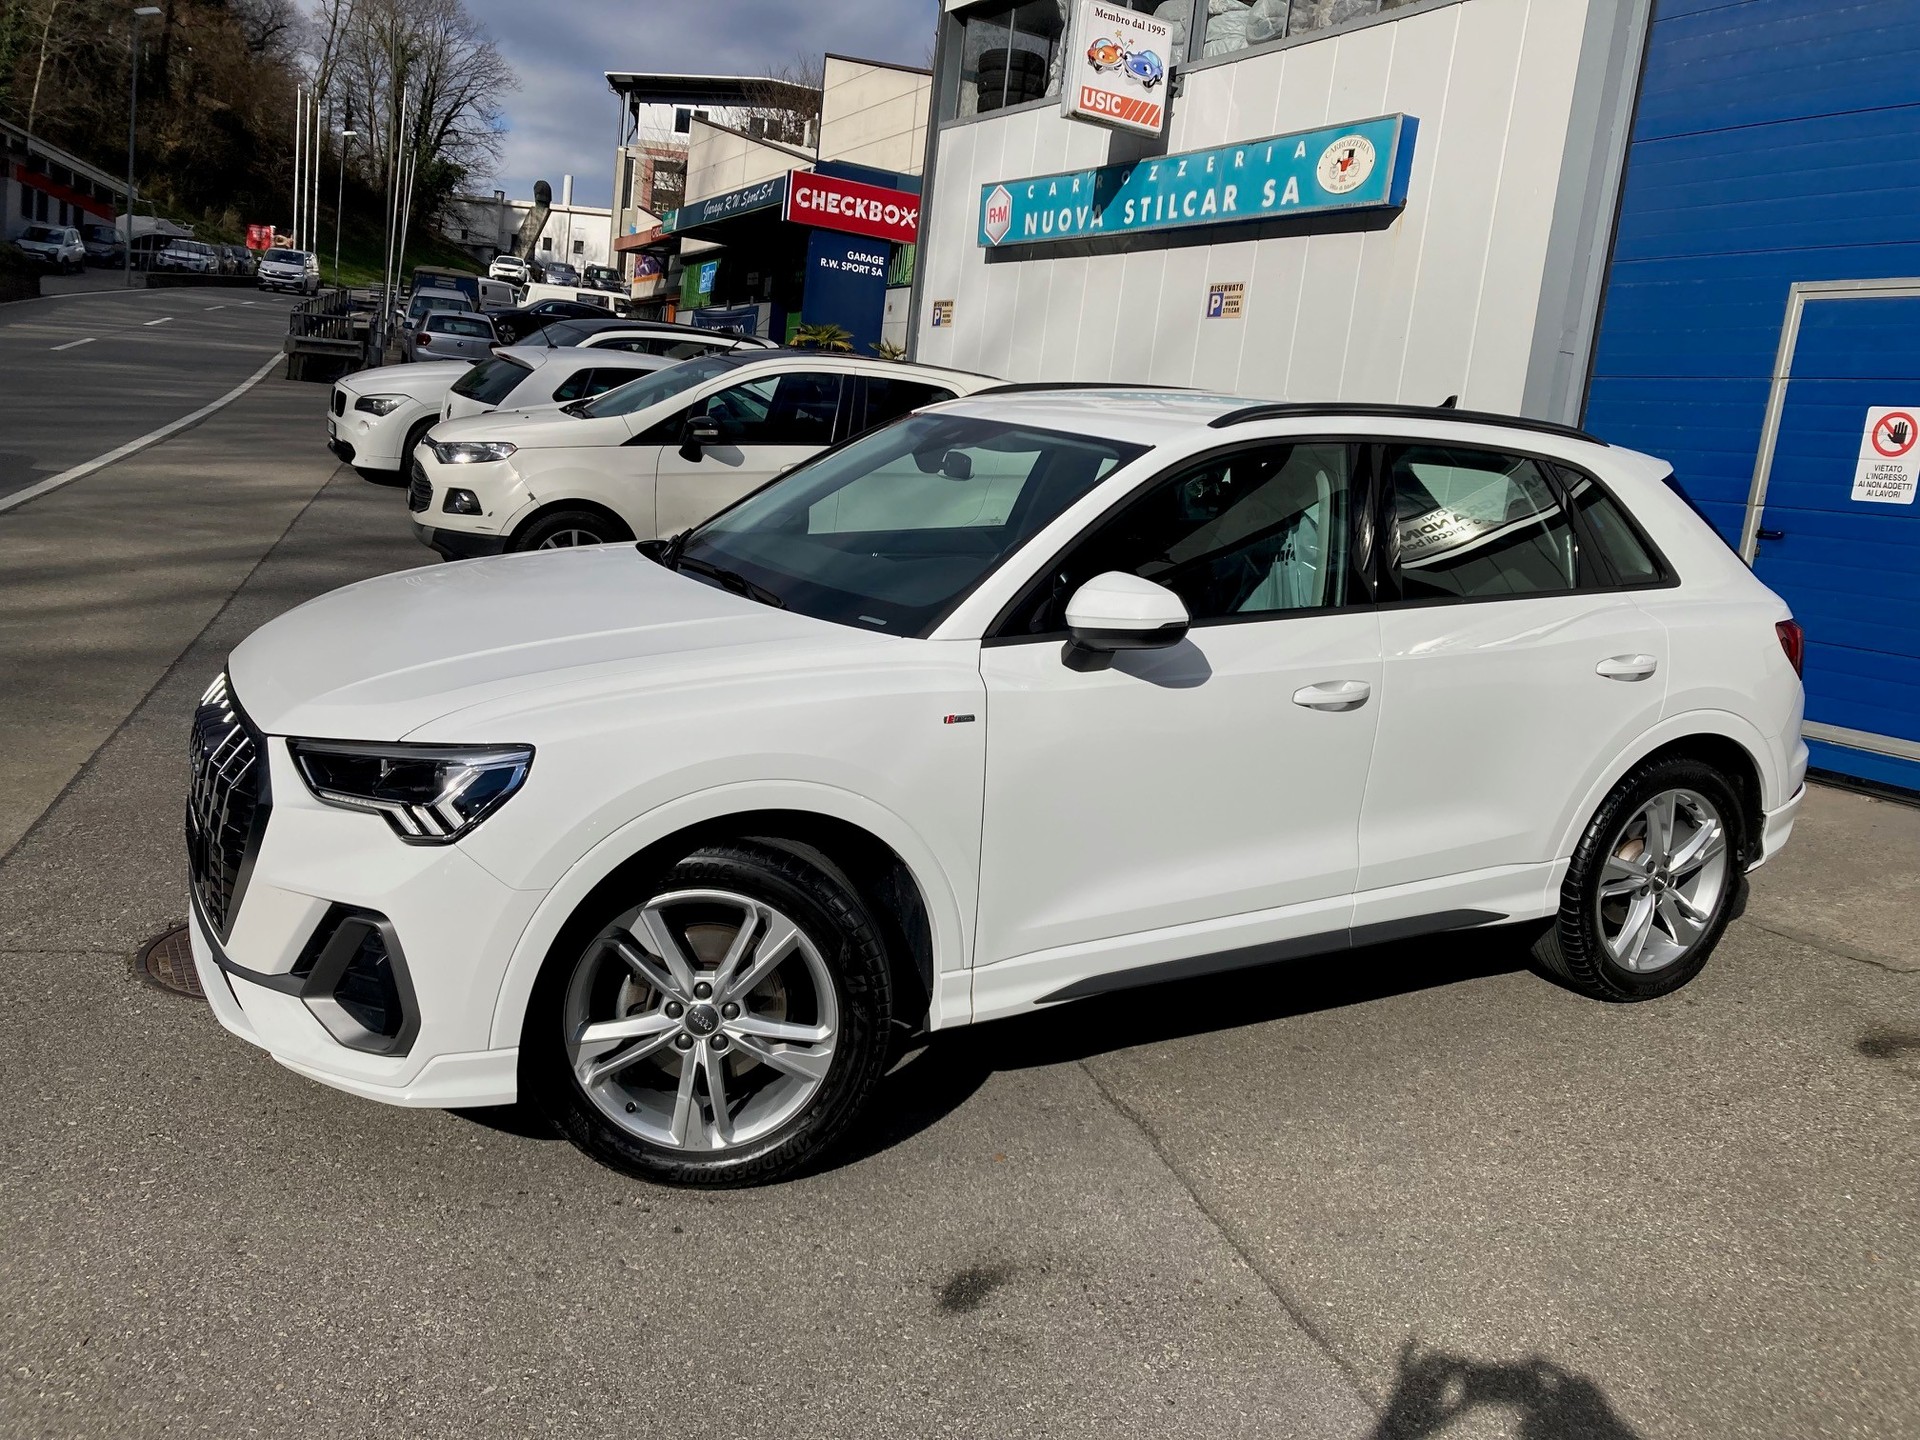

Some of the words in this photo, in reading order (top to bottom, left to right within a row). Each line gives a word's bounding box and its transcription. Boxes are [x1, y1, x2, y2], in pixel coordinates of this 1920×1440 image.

[1094, 7, 1131, 25] Membro
[1132, 19, 1145, 30] dal
[1147, 23, 1166, 36] 1995
[1083, 88, 1122, 114] USIC
[1027, 140, 1306, 199] CARROZZERIA
[703, 200, 724, 221] Garage
[740, 190, 760, 208] Sport
[795, 187, 919, 229] CHECKBOX
[1024, 204, 1104, 236] NUOVA
[1123, 184, 1238, 225] STILCAR
[1261, 176, 1300, 208] SA
[820, 257, 839, 270] R.W.
[841, 261, 870, 275] SPORT
[871, 266, 883, 277] SA
[847, 250, 885, 266] GARAGE
[1210, 283, 1244, 293] RISERVATO
[1210, 295, 1221, 316] P
[1865, 472, 1908, 482] L'INGRESSO
[1874, 464, 1903, 473] VIETATO
[1857, 480, 1866, 488] AI
[1866, 481, 1881, 489] NON
[1882, 482, 1913, 491] ADDETTI
[1866, 489, 1874, 497] AI
[1874, 489, 1901, 498] LAVORI
